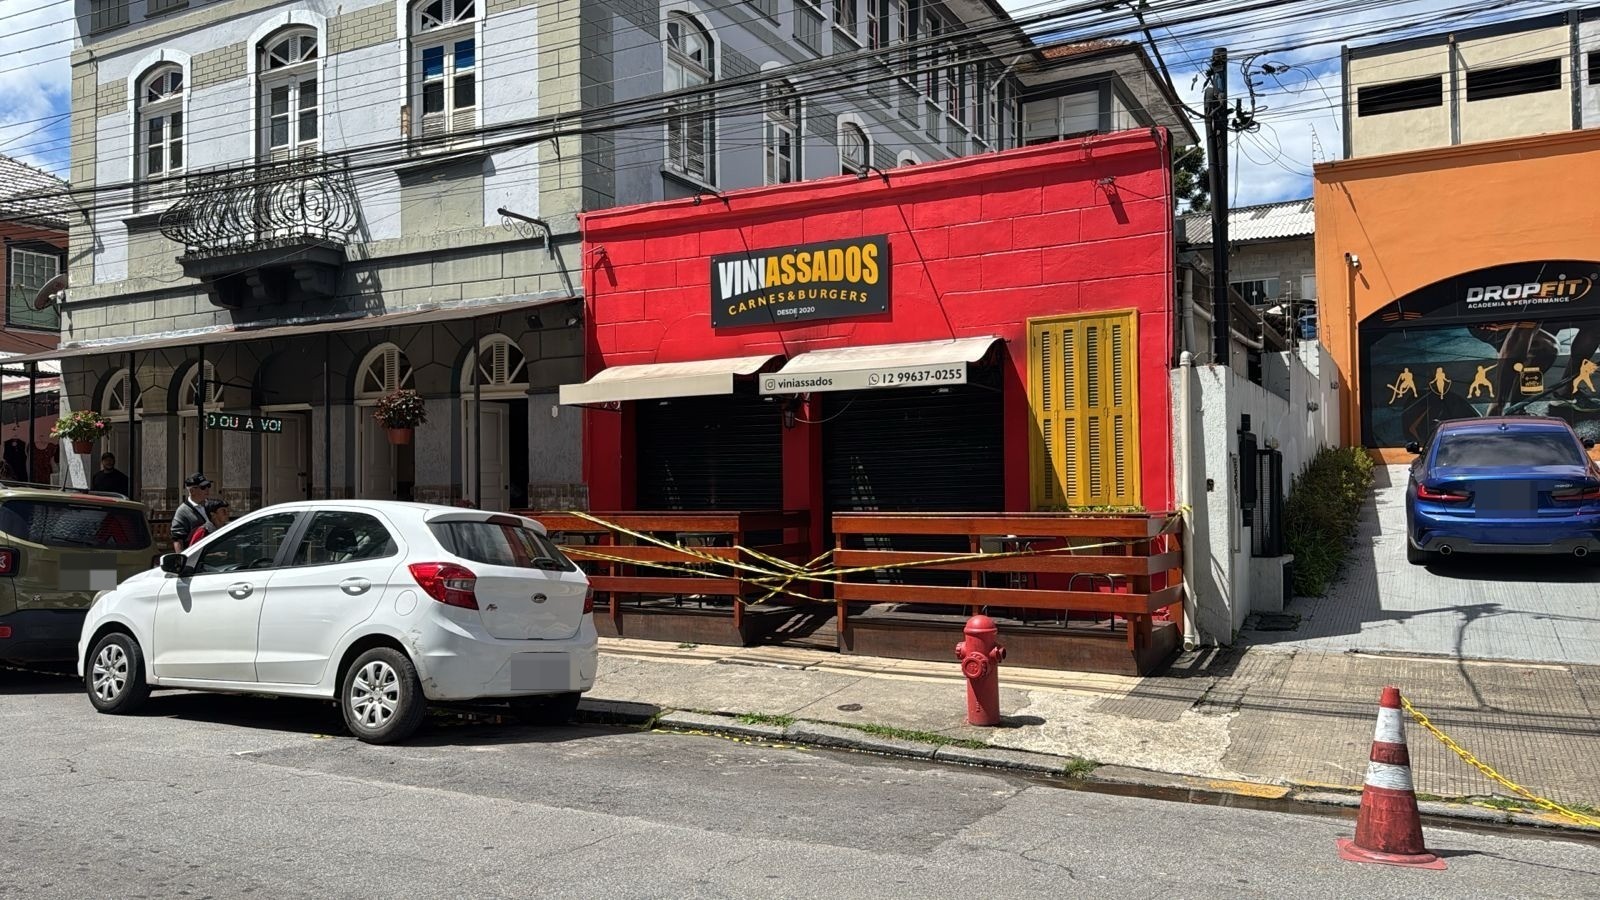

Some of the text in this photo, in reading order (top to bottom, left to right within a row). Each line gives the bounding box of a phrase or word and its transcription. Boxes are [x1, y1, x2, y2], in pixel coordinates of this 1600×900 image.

[718, 243, 879, 300] VINIASSADOS
[1468, 301, 1505, 309] ACADEMIA
[1513, 297, 1570, 305] PERFORMANCE
[777, 306, 815, 316] DESDE 2020
[778, 376, 833, 389] viniassados
[882, 369, 962, 383] 12 99637-0255
[220, 416, 239, 428] OU
[245, 418, 254, 429] A
